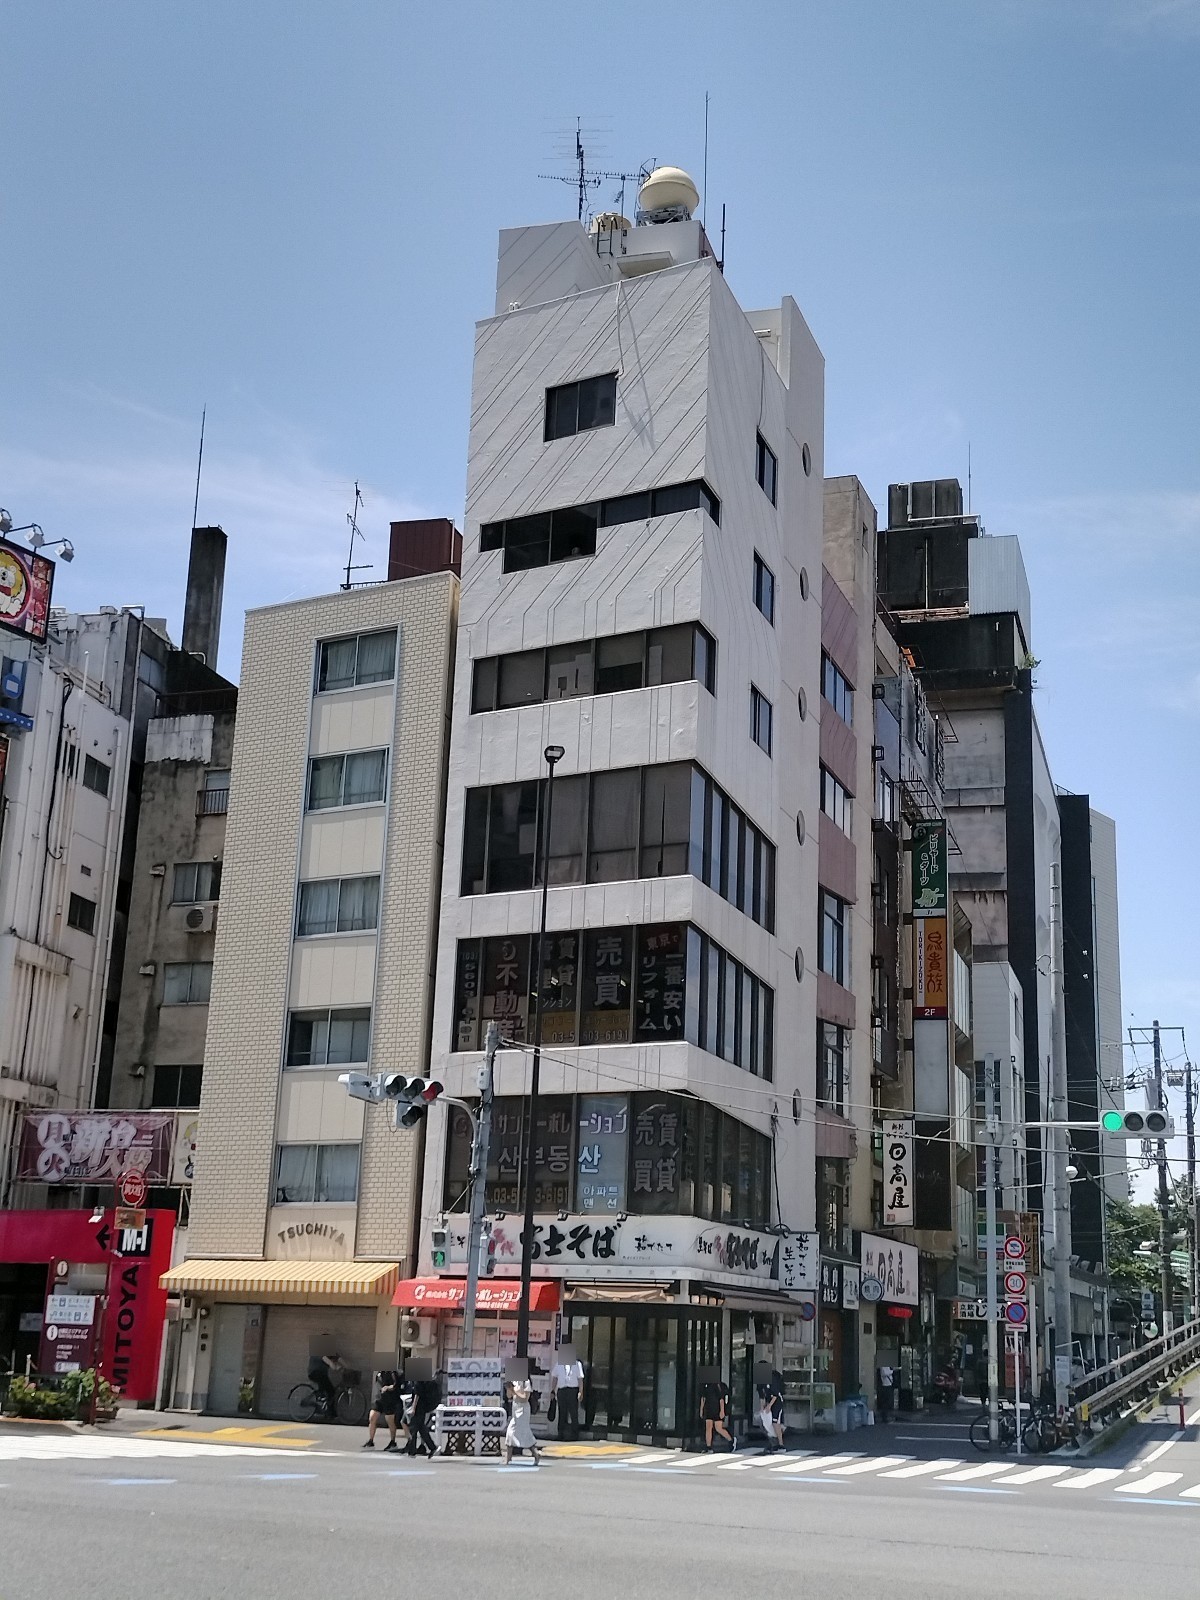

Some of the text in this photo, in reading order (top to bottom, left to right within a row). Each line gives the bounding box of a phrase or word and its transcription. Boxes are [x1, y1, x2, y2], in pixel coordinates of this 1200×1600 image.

[929, 833, 939, 875] ビリヤード
[594, 936, 623, 1007] 売買
[639, 955, 659, 1030] リフォーム
[662, 952, 685, 1031] 一番安い
[926, 931, 943, 993] 鳥貴族
[924, 1008, 936, 1016] 2F
[633, 1113, 655, 1193] 売買
[657, 1112, 679, 1193] 賃貸
[888, 1143, 909, 1210] 日高屋
[277, 1222, 345, 1246] TSUCHIYA
[782, 1246, 796, 1287] 生そば
[1009, 1278, 1022, 1289] 30
[111, 1265, 140, 1395] MITOYA
